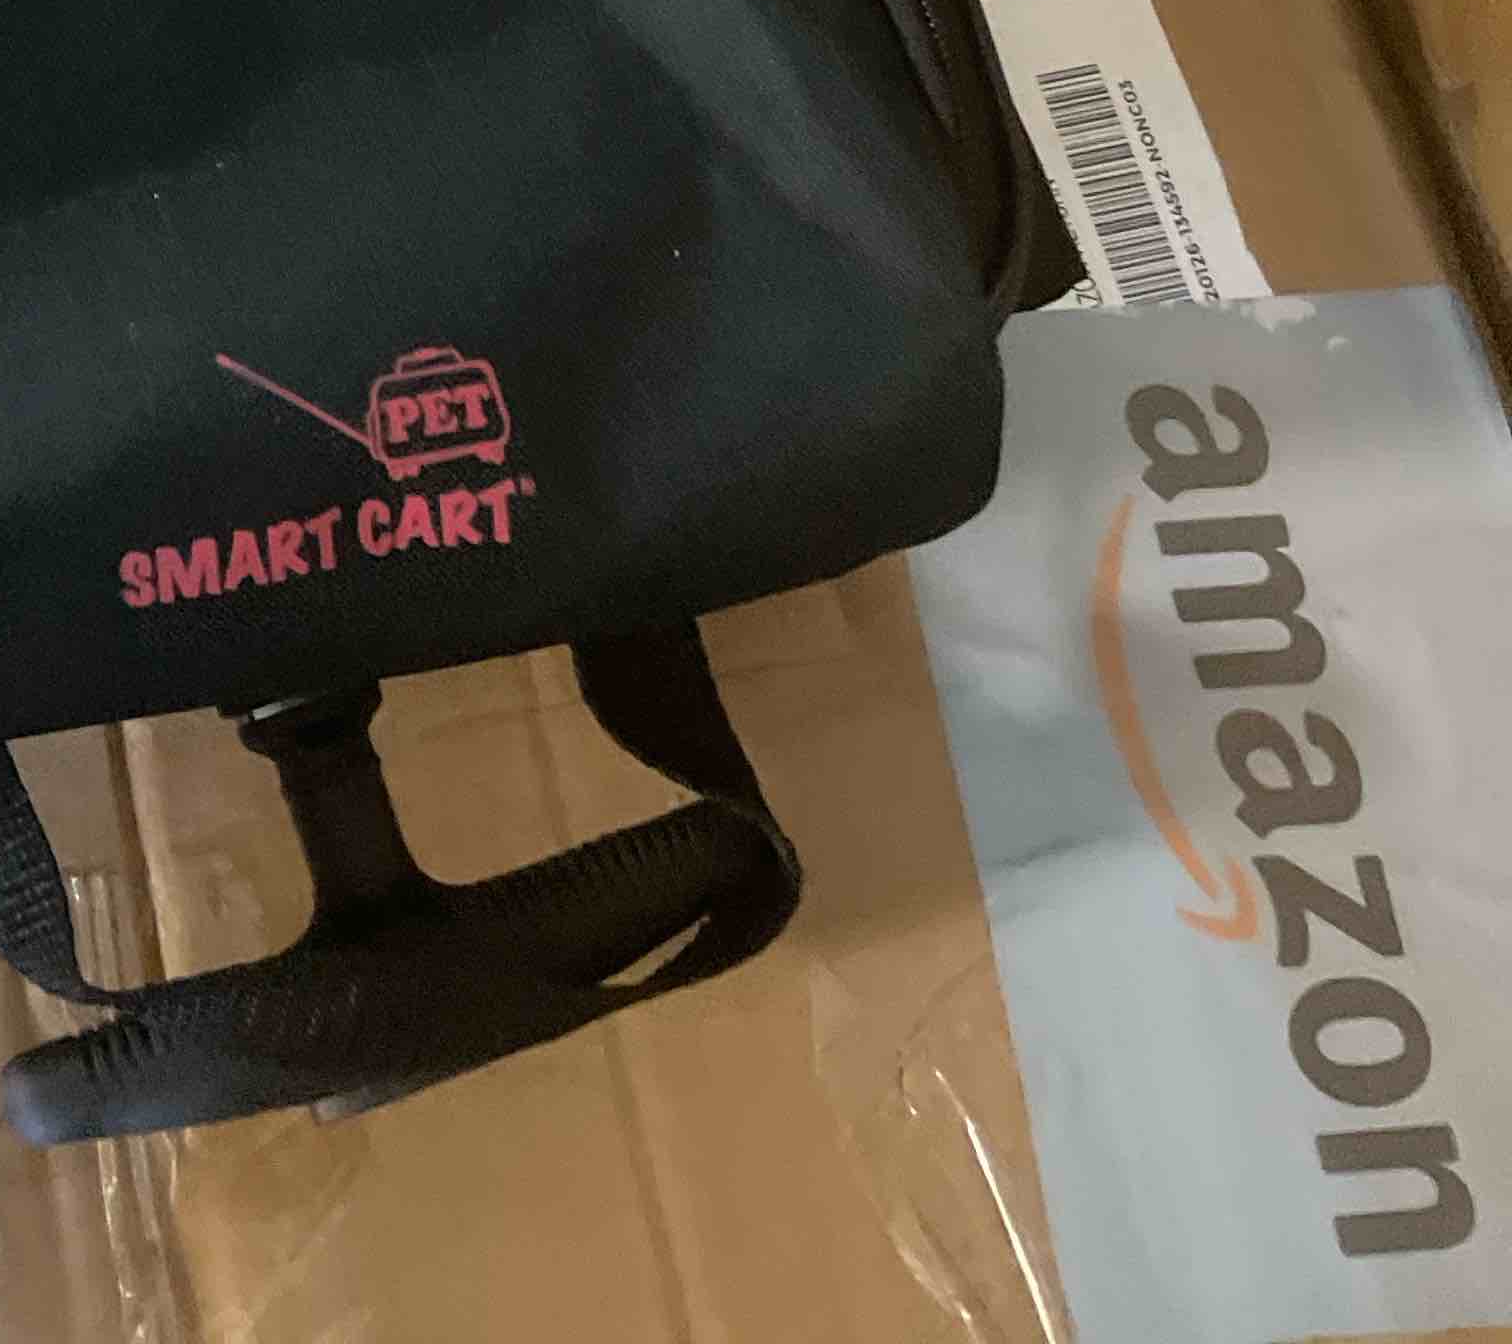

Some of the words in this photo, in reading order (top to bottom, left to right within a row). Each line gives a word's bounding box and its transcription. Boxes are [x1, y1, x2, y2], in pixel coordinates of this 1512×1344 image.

[385, 382, 491, 444] PET
[118, 506, 343, 609] SMART
[1123, 382, 1476, 1260] amazon
